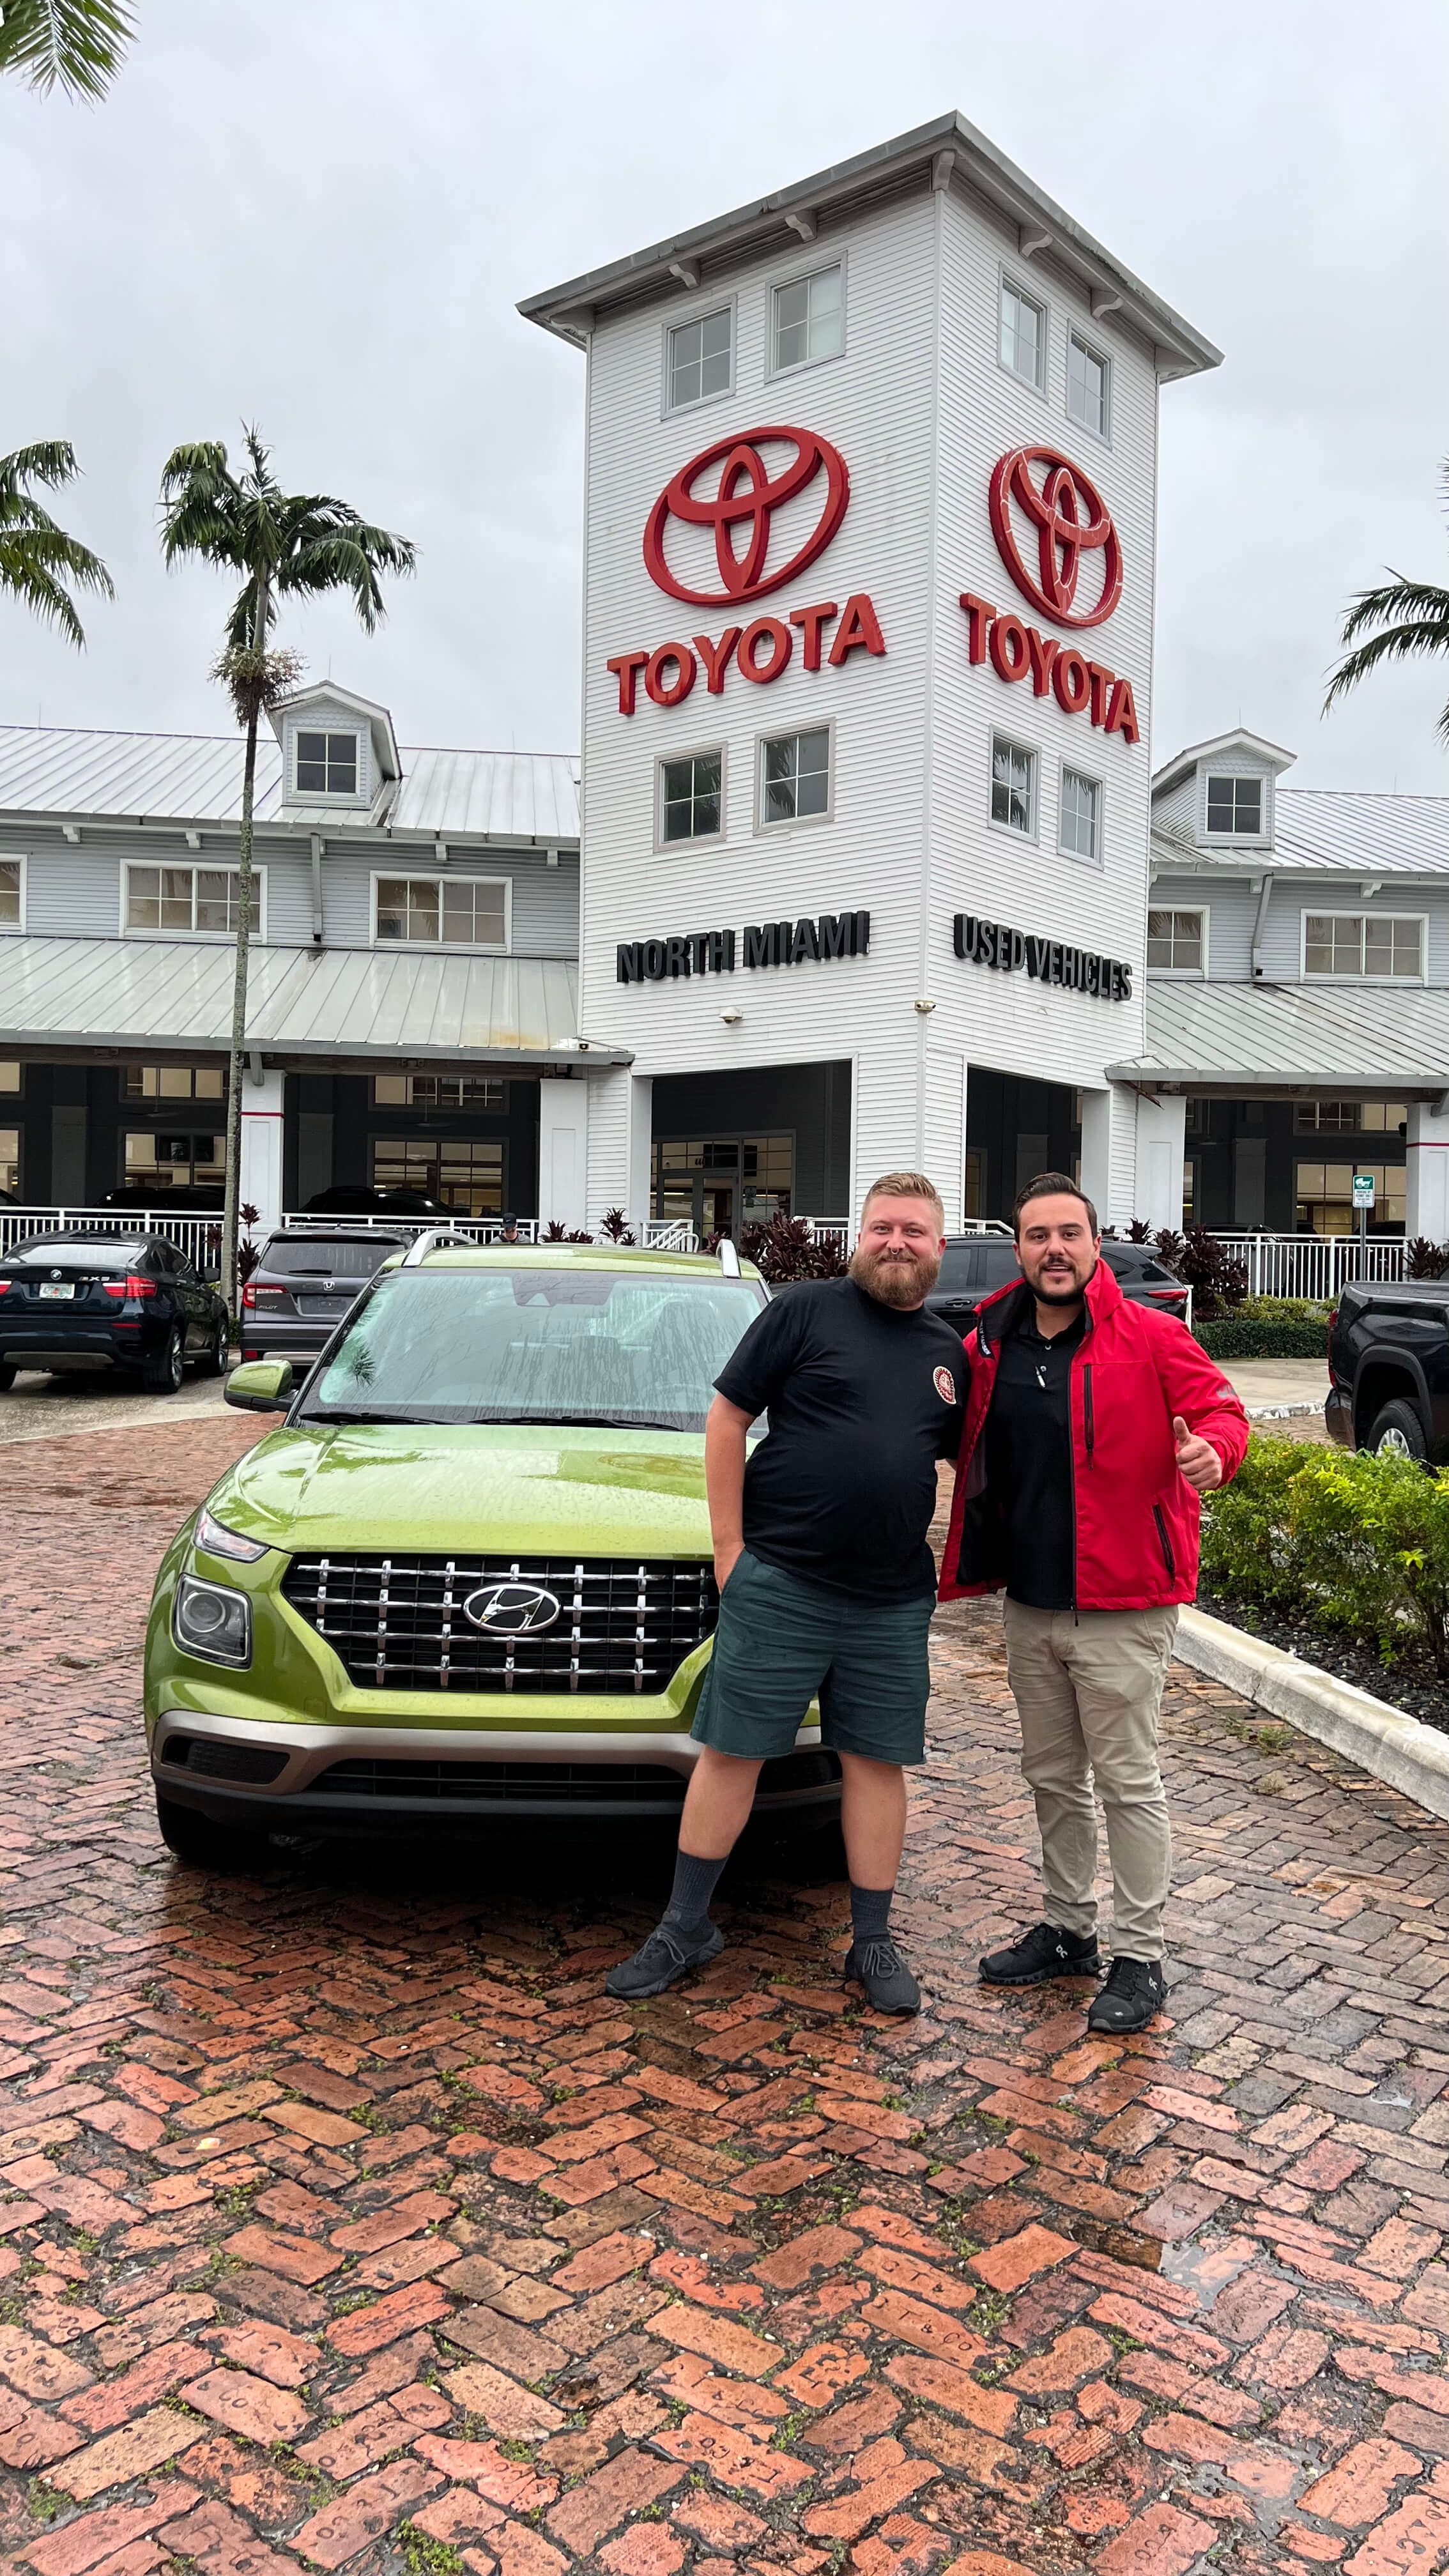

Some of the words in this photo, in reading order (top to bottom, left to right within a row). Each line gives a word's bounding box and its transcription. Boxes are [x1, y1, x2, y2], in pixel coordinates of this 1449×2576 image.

[607, 593, 887, 716] TOYOTA
[960, 592, 1140, 744] TOYOTA
[617, 928, 735, 983] NORTH
[743, 910, 870, 968] MIAMI
[954, 914, 1025, 971] USED
[1025, 935, 1133, 1001] VEHICLES
